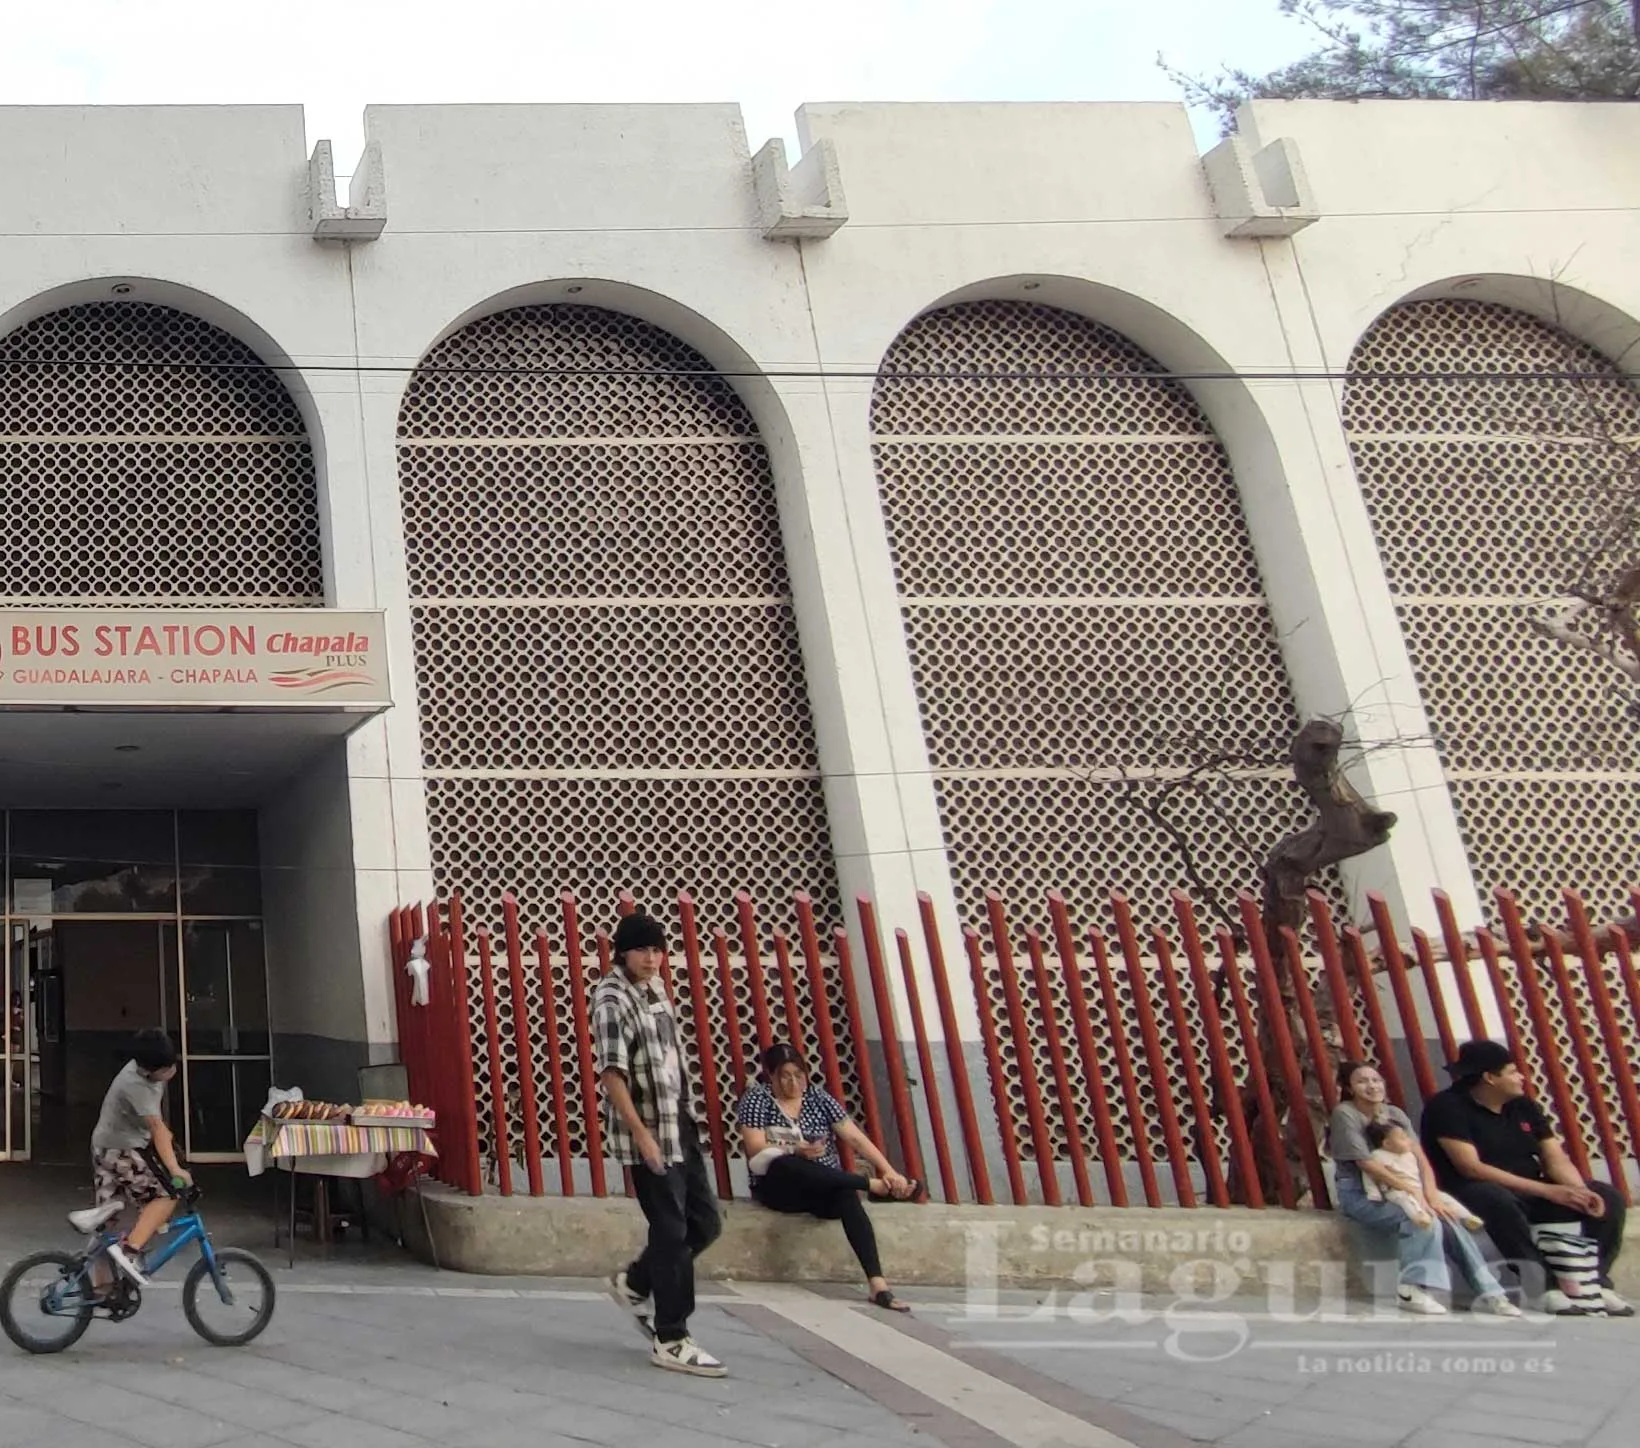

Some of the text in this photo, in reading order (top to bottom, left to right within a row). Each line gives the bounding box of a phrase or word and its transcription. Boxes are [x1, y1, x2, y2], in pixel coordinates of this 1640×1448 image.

[12, 625, 256, 656] BUS STATION
[266, 632, 369, 656] Chapala
[326, 655, 367, 667] PLUS
[13, 669, 151, 684] GUADALAJARA
[170, 669, 258, 684] CHAPALA
